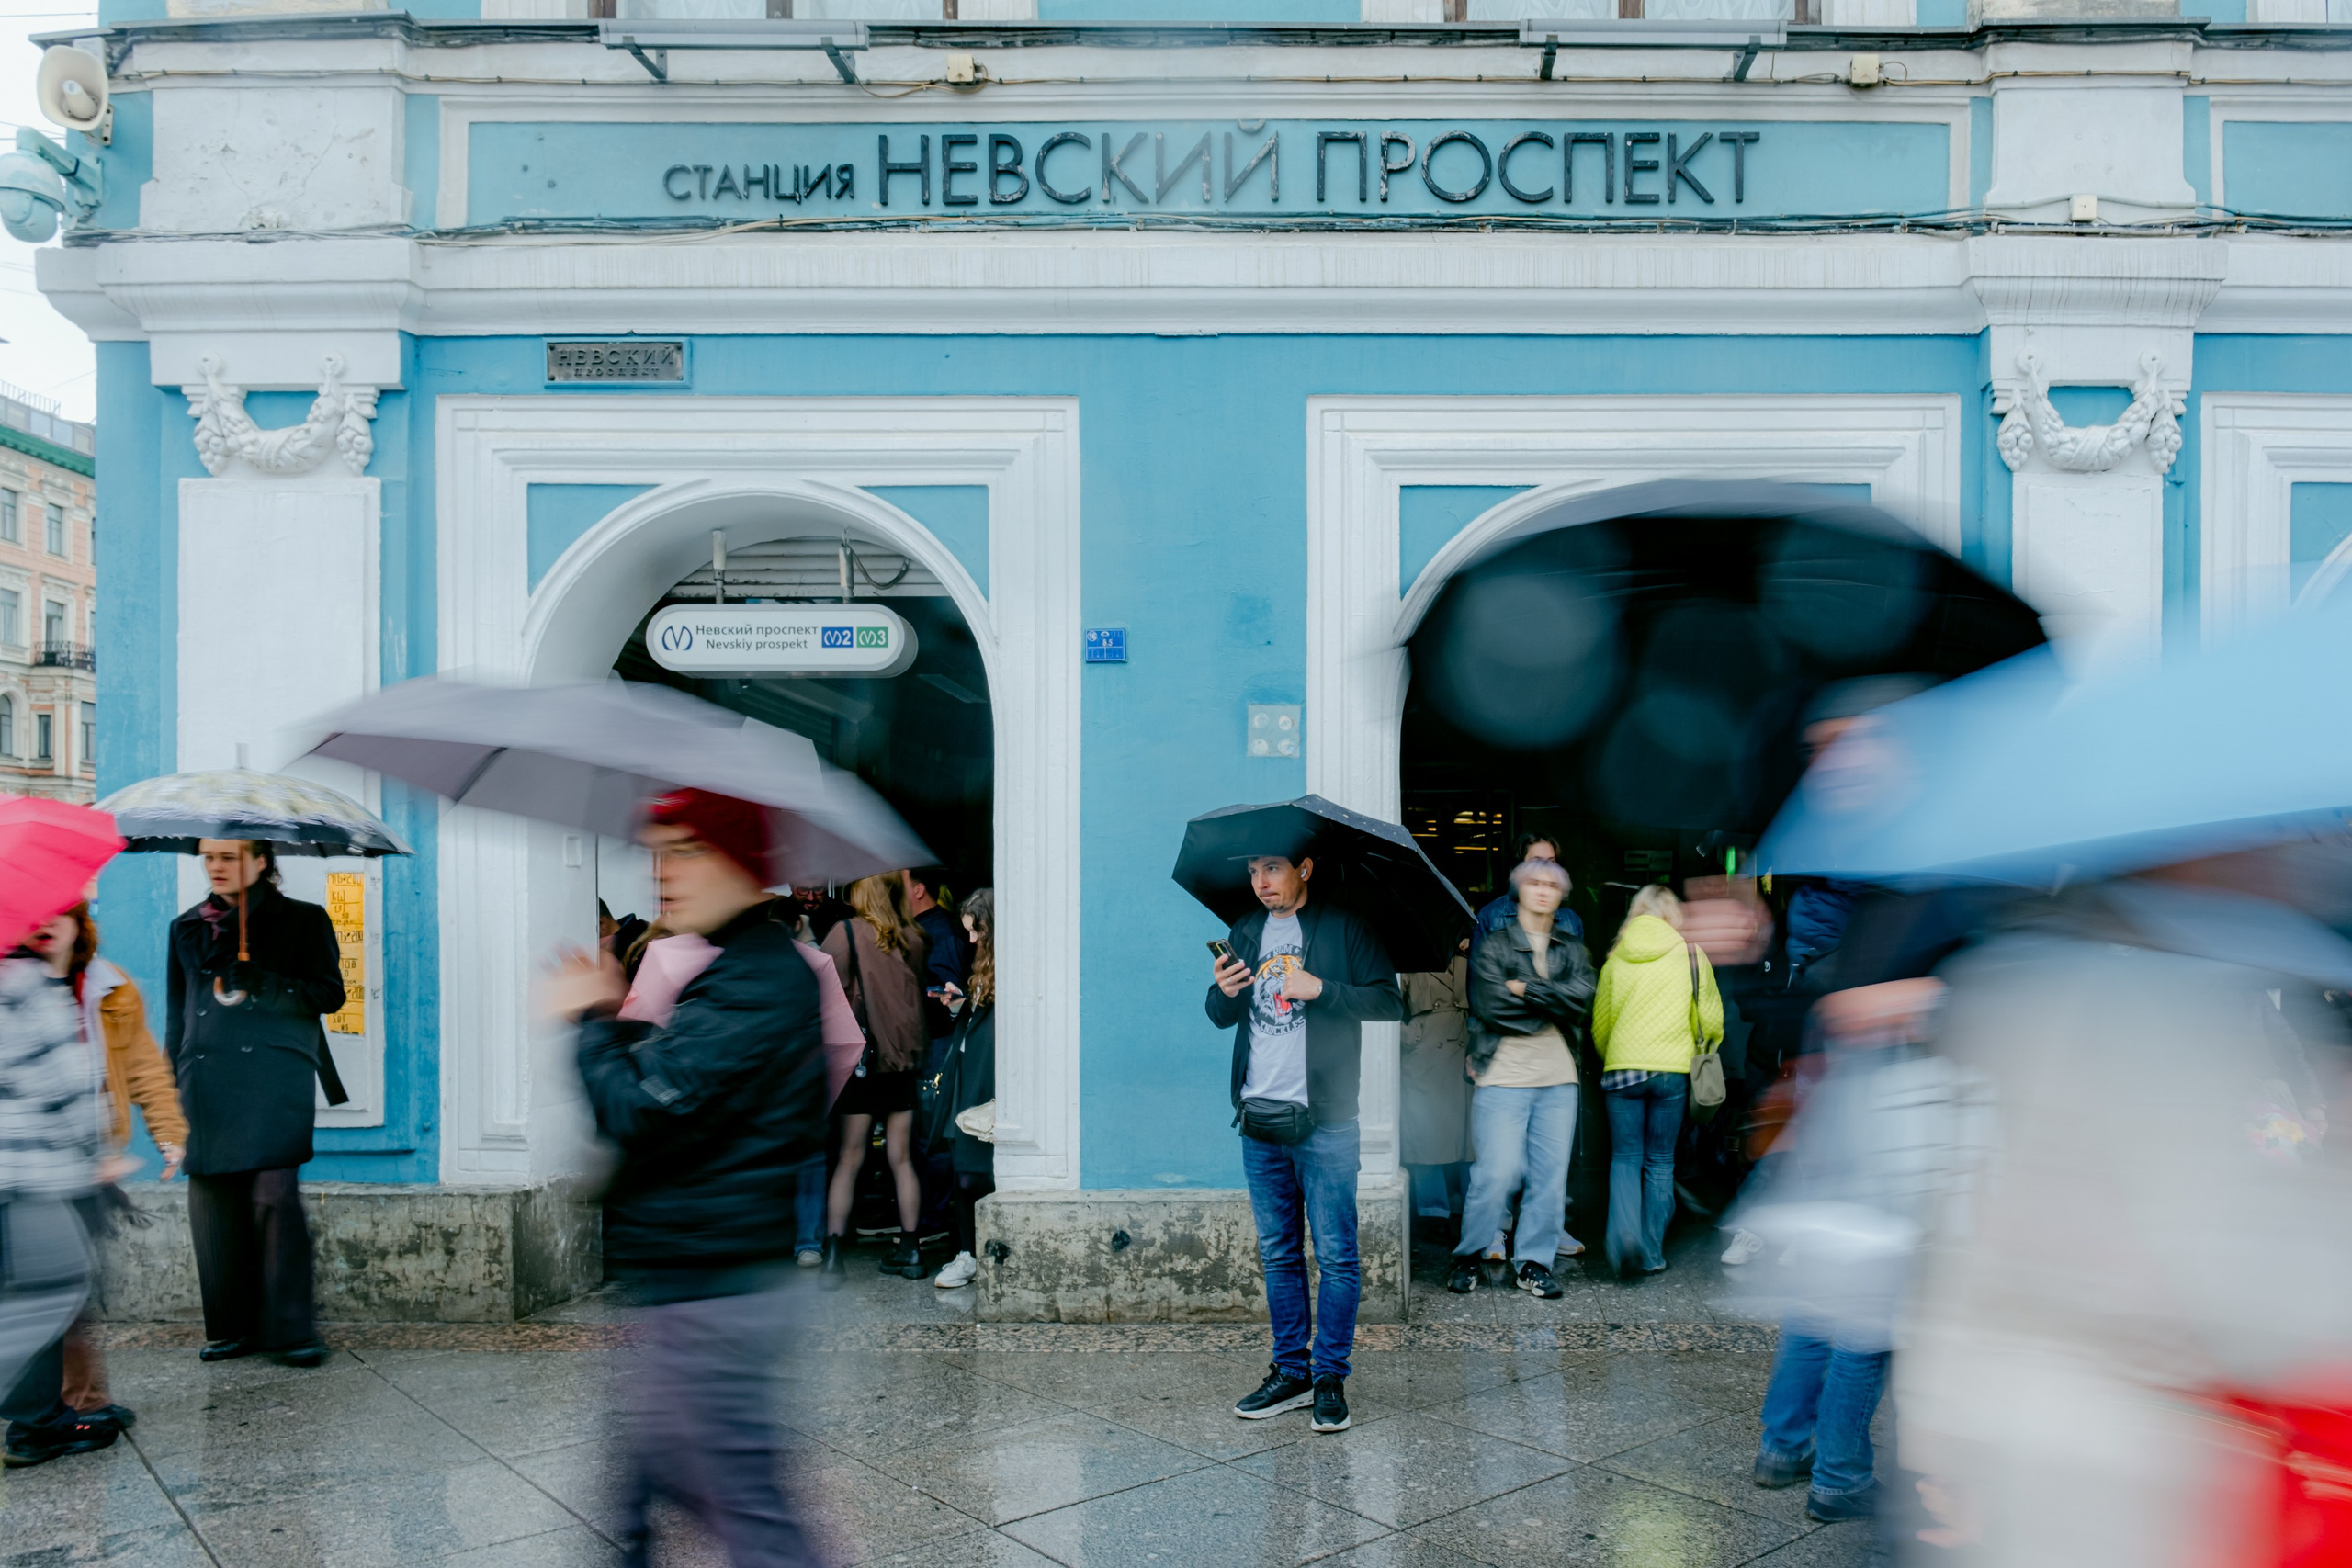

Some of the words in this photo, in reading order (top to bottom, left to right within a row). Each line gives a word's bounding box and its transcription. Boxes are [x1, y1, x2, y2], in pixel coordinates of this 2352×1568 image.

[662, 163, 854, 204] СТАНЦИЯ
[878, 118, 1280, 207] НЕВСКИЙ
[1317, 130, 1760, 204] ПРОСПЕКТ
[558, 345, 674, 366] НЕВСКИЙ
[573, 367, 660, 378] ПРОСПЕКТ
[695, 624, 752, 636] Невский
[756, 626, 819, 637] проспект
[706, 638, 752, 651] Nevskiy
[755, 638, 808, 651] prospekt
[1272, 944, 1293, 958] RUM
[1261, 1015, 1306, 1036] KNUCKLES
